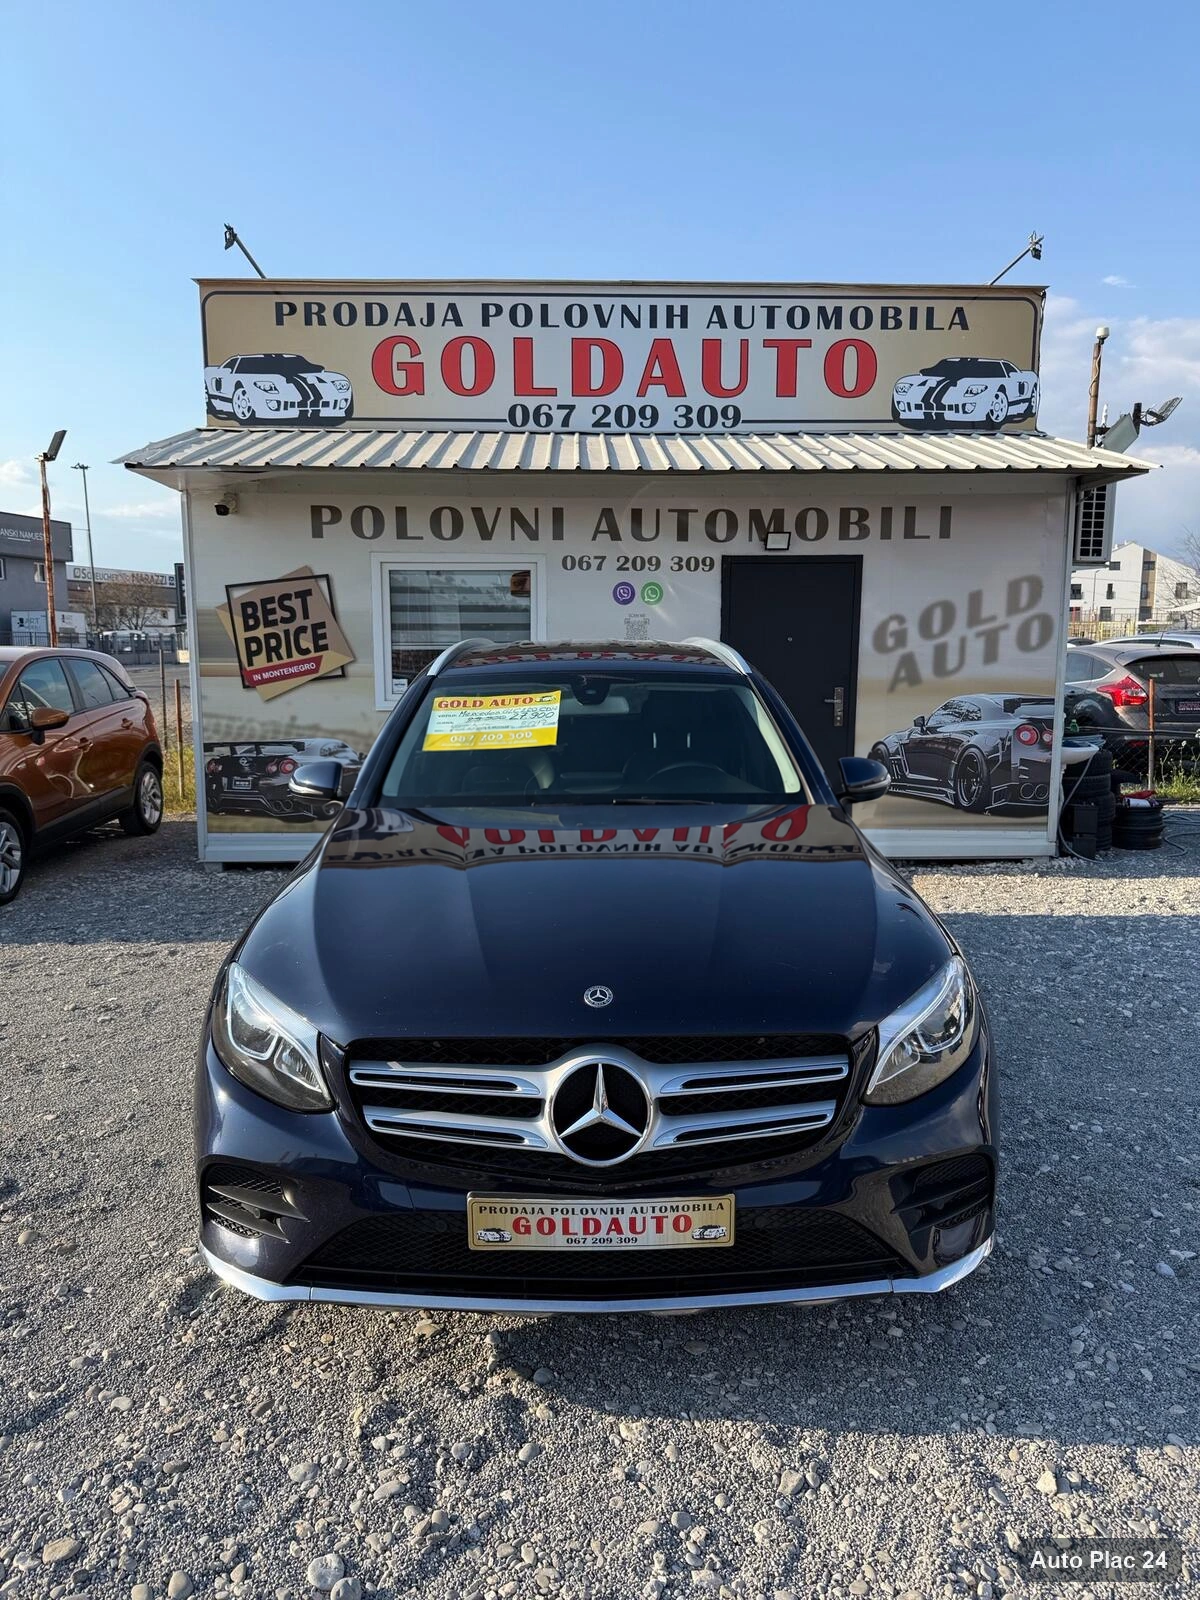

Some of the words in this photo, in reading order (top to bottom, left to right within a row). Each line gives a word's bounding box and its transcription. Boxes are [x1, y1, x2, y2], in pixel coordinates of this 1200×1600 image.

[274, 301, 464, 328] PRODAJA
[481, 303, 689, 329] POLOVNIH
[706, 304, 970, 331] AUTOMOBILA
[371, 335, 878, 398] GOLDAUTO
[506, 403, 577, 429] 067
[591, 404, 659, 429] 209
[673, 404, 742, 429] 309
[309, 504, 565, 542] POLOVNI
[591, 505, 953, 543] AUTOMOBILI
[561, 555, 607, 571] 067
[616, 555, 661, 572] 209
[670, 556, 715, 572] 309
[240, 589, 313, 633] BEST
[872, 574, 1043, 655] GOLD
[244, 621, 329, 667] PRICE
[887, 612, 1055, 693] AUTO
[253, 673, 262, 681] IN
[262, 662, 316, 680] MONTENEGRO
[437, 700, 484, 709] GOLD
[489, 696, 534, 707] AUTO
[479, 1205, 544, 1216] PRODAJA
[551, 1206, 625, 1216] POLOVNIH
[630, 1202, 725, 1215] AUTOMOBILA
[512, 1214, 693, 1236] GOLDAUTO
[566, 1237, 587, 1245] 067
[591, 1237, 613, 1245] 209
[616, 1236, 638, 1244] 309
